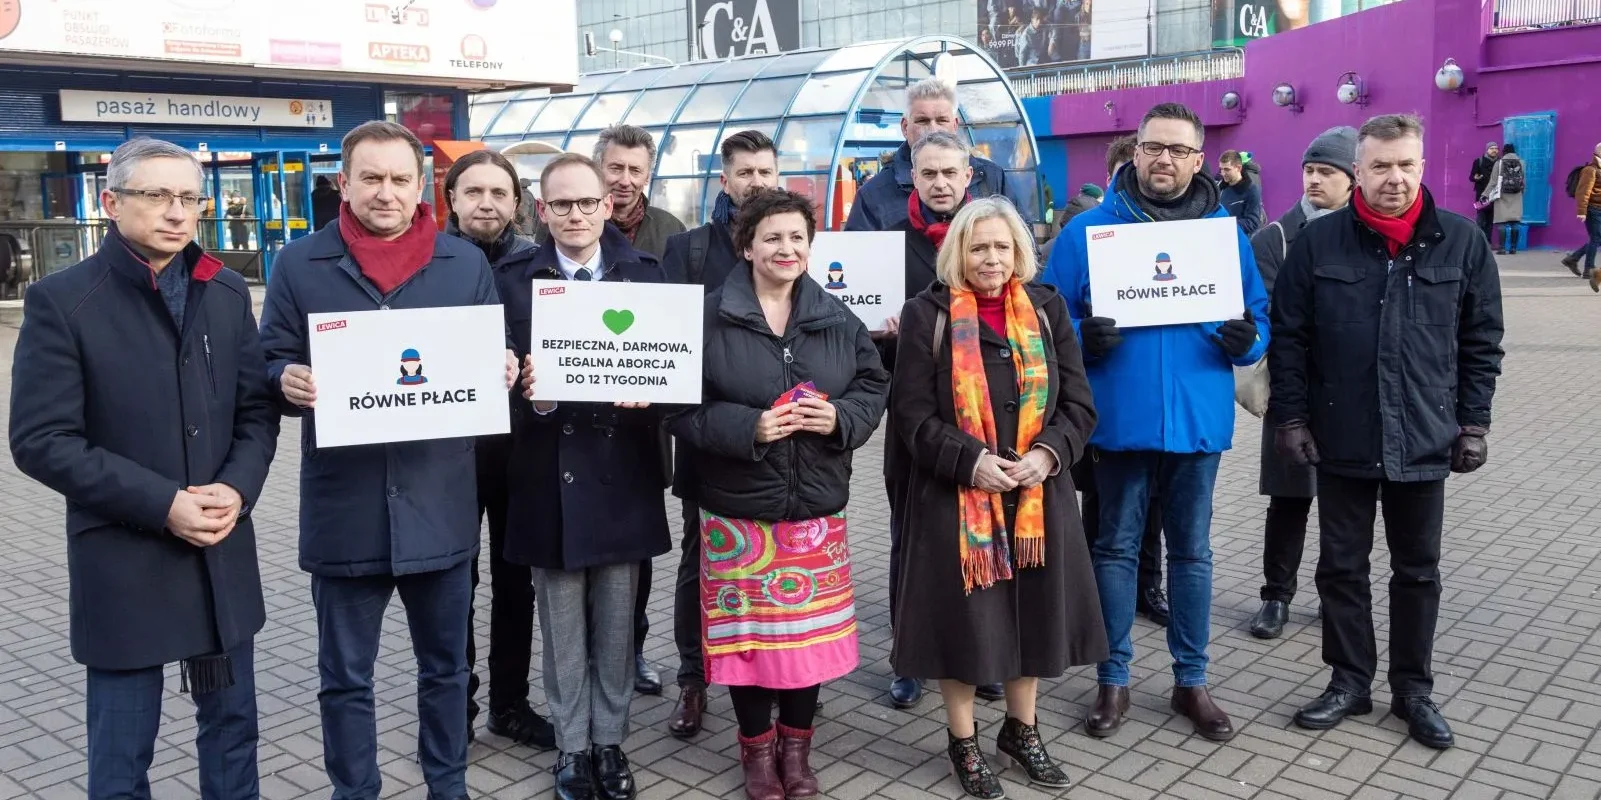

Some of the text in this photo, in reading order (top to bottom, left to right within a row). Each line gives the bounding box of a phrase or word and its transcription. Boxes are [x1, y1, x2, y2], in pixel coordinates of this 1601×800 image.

[1239, 3, 1270, 37] C&A
[702, 0, 780, 59] C&A
[371, 45, 428, 61] APTEKA
[449, 59, 504, 70] TELEFONY
[97, 98, 260, 122] pasaż handlowy
[540, 287, 565, 295] LEWICA
[1117, 283, 1216, 300] RÓWNE PŁACE
[842, 294, 882, 305] PŁACE
[317, 320, 347, 332] LEWICA
[542, 339, 693, 354] BEZPIECZNA, DARMOWA,
[558, 357, 676, 370] LEGALNA ABORCJA
[566, 374, 668, 386] DO 12 TYGODNIA
[349, 388, 477, 410] RÓWNE PŁACE
